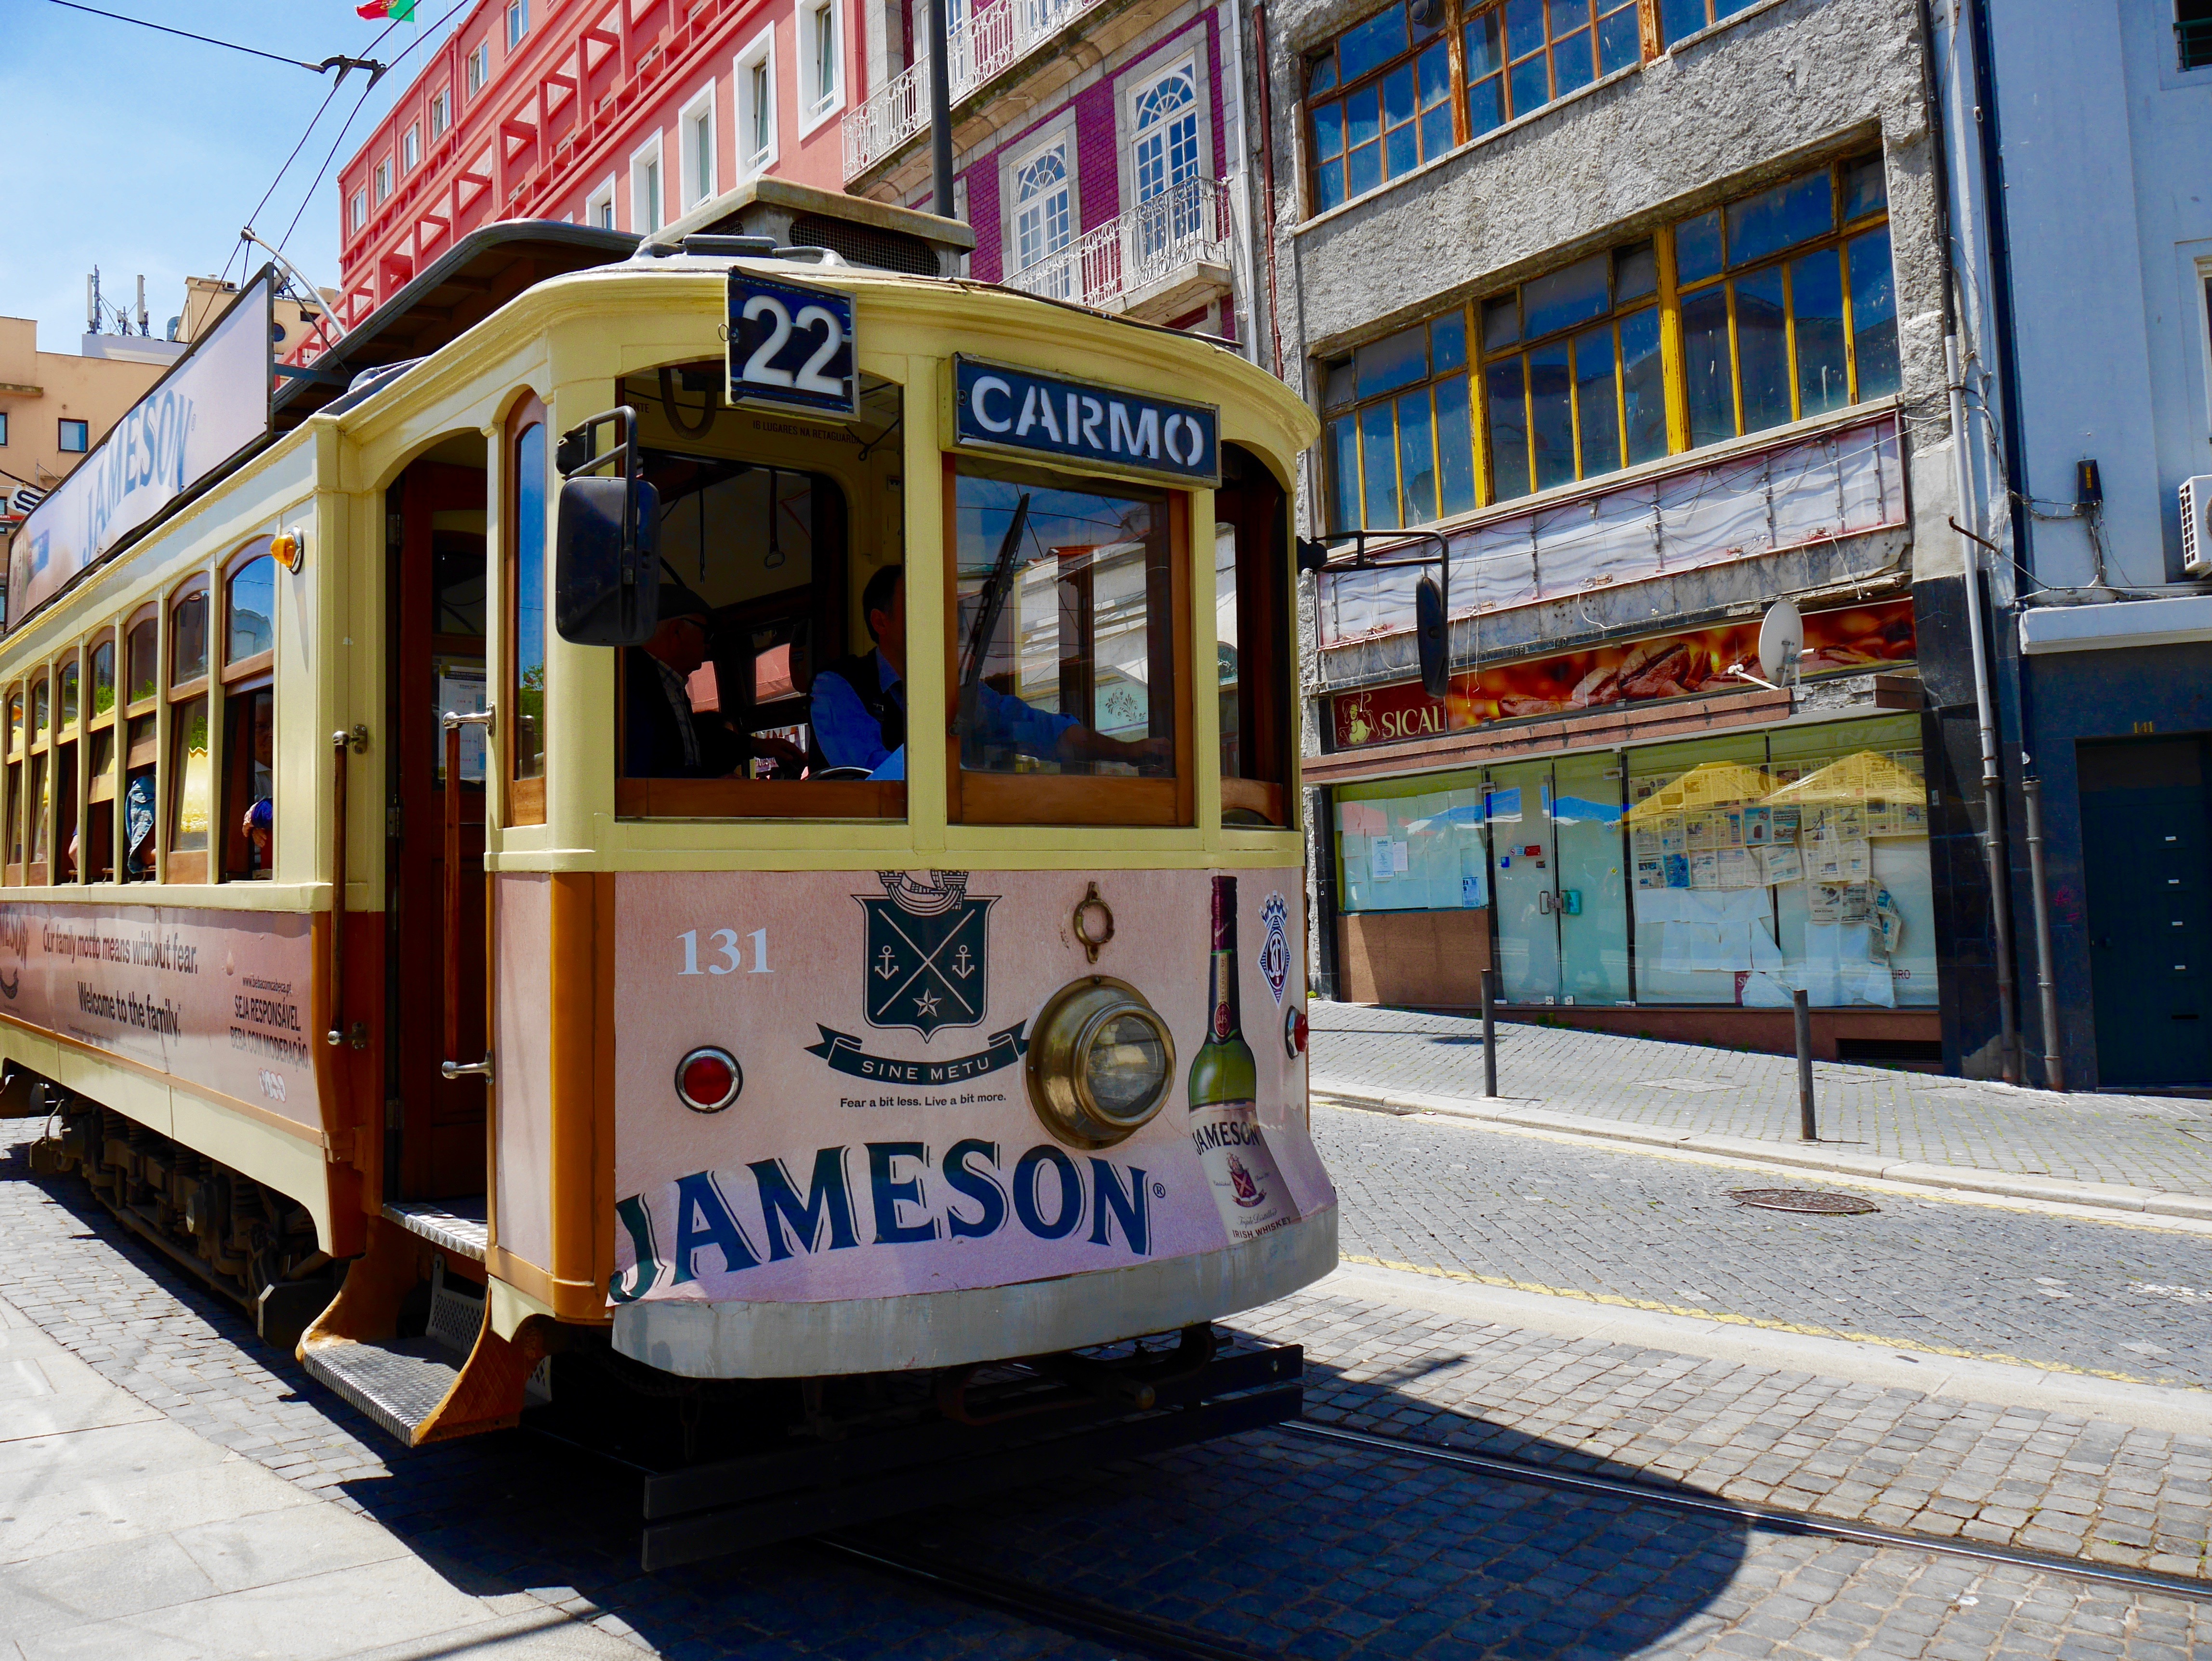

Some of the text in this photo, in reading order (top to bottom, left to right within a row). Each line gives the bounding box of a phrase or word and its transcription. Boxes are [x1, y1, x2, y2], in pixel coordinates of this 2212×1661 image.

[742, 295, 843, 395] 22
[763, 422, 798, 435] LUGARES
[800, 427, 810, 437] NA
[813, 429, 861, 445] RETAGUARDA
[972, 376, 1204, 466] CARMO
[1381, 705, 1445, 738] SICAL
[2133, 721, 2154, 734] 141
[56, 924, 77, 964] family
[78, 928, 100, 960] motto
[103, 937, 130, 964] means
[133, 930, 171, 970] without
[173, 932, 198, 974] fear.
[676, 927, 774, 975] 131
[78, 981, 115, 1020] Welcome
[117, 990, 127, 1023] to
[128, 991, 145, 1028] the
[235, 994, 250, 1021] SEJA
[230, 1026, 248, 1052] BEBA
[248, 1029, 263, 1057] COM
[861, 1057, 989, 1080] SINE METU
[840, 1097, 866, 1107] Fear
[880, 1096, 894, 1107] bit
[897, 1096, 922, 1107] less.
[925, 1096, 947, 1107] Live
[960, 1094, 974, 1104] bit
[977, 1093, 1007, 1102] more.
[1192, 1121, 1260, 1156] JAMESON
[1232, 1216, 1291, 1239] IRISH WHISKEY
